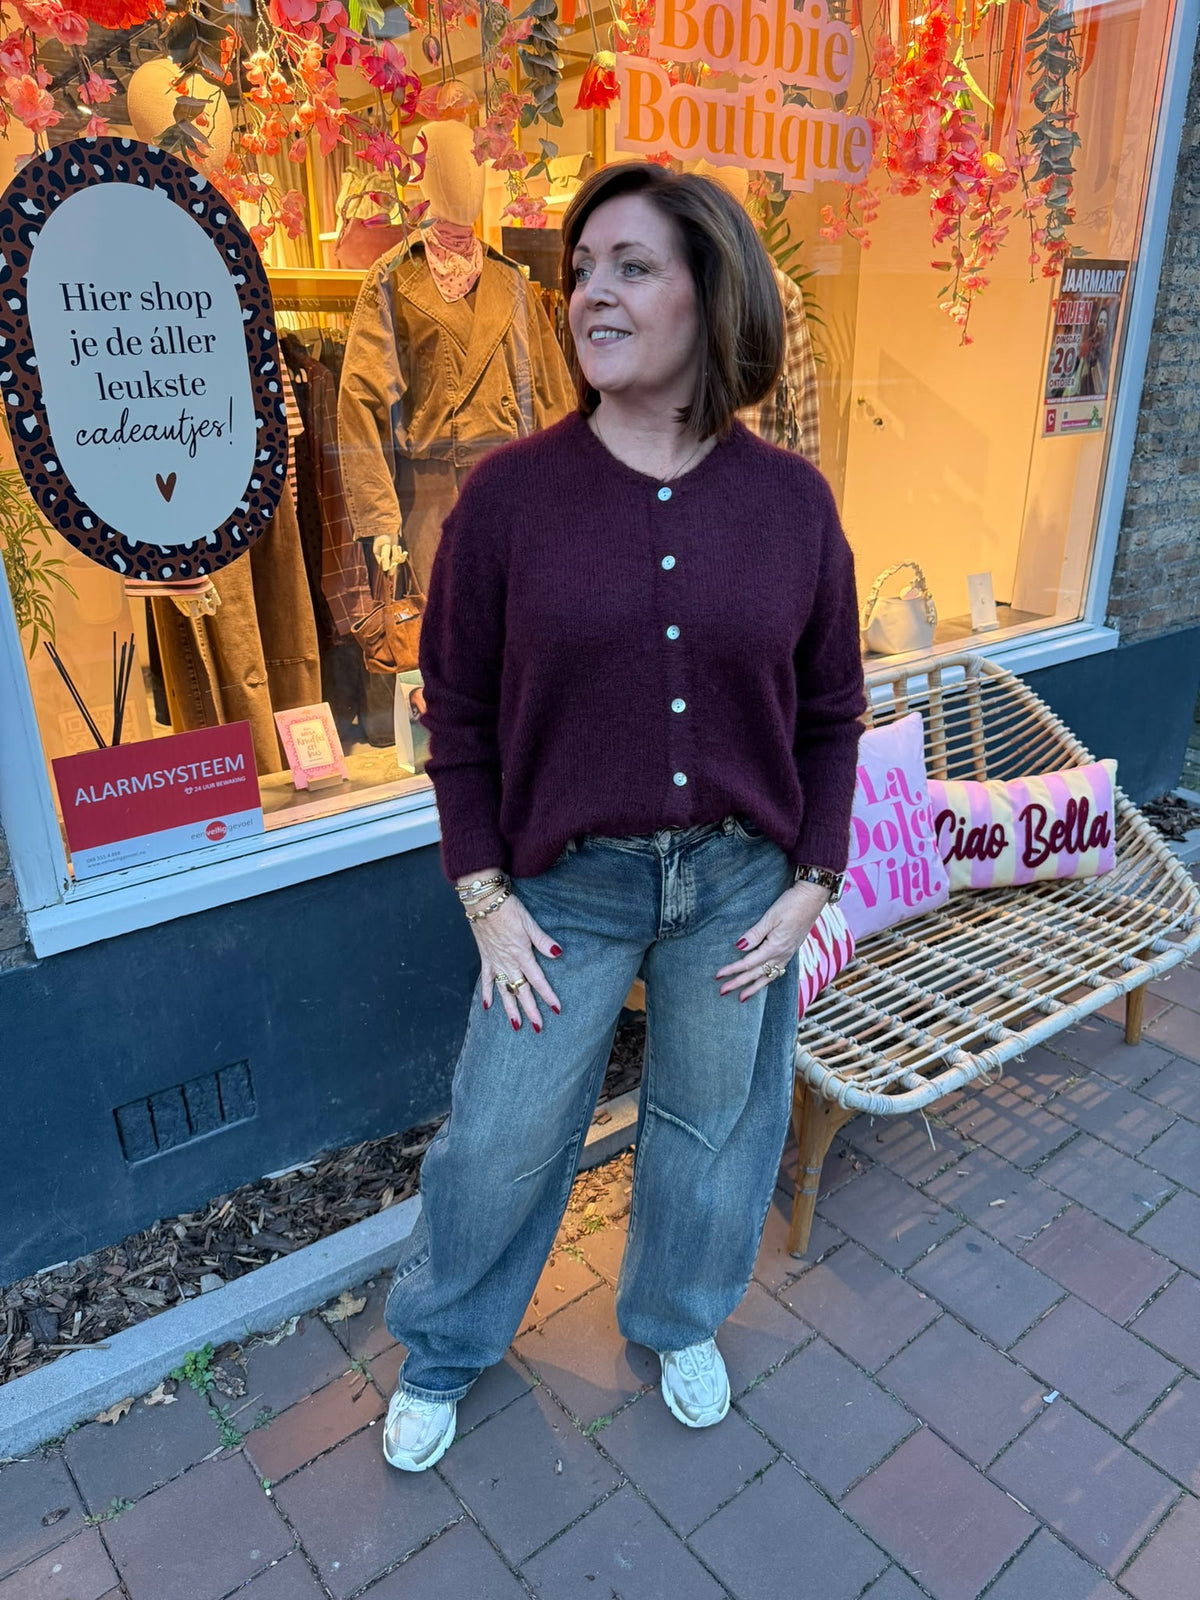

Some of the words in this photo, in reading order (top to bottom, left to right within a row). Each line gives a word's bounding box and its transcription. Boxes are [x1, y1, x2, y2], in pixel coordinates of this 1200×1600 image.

[659, 0, 849, 83] Bobbie
[624, 67, 866, 181] Boutique
[59, 282, 133, 312] Hier
[141, 281, 213, 318] shop
[1062, 268, 1126, 293] JAARMARKT
[1056, 300, 1094, 325] RIJEN
[70, 328, 99, 367] je
[106, 326, 143, 357] de
[150, 325, 216, 354] áller
[1056, 335, 1081, 345] DINSDAG
[1051, 347, 1077, 376] 20
[94, 370, 207, 401] leukste
[76, 396, 234, 458] cadeautjes!
[75, 754, 245, 806] ALARMSYSTEEM
[856, 764, 922, 806] La
[228, 818, 253, 832] gevoel
[934, 808, 1008, 866] Ciao
[1018, 796, 1110, 868] Bella
[846, 855, 941, 910] Vita
